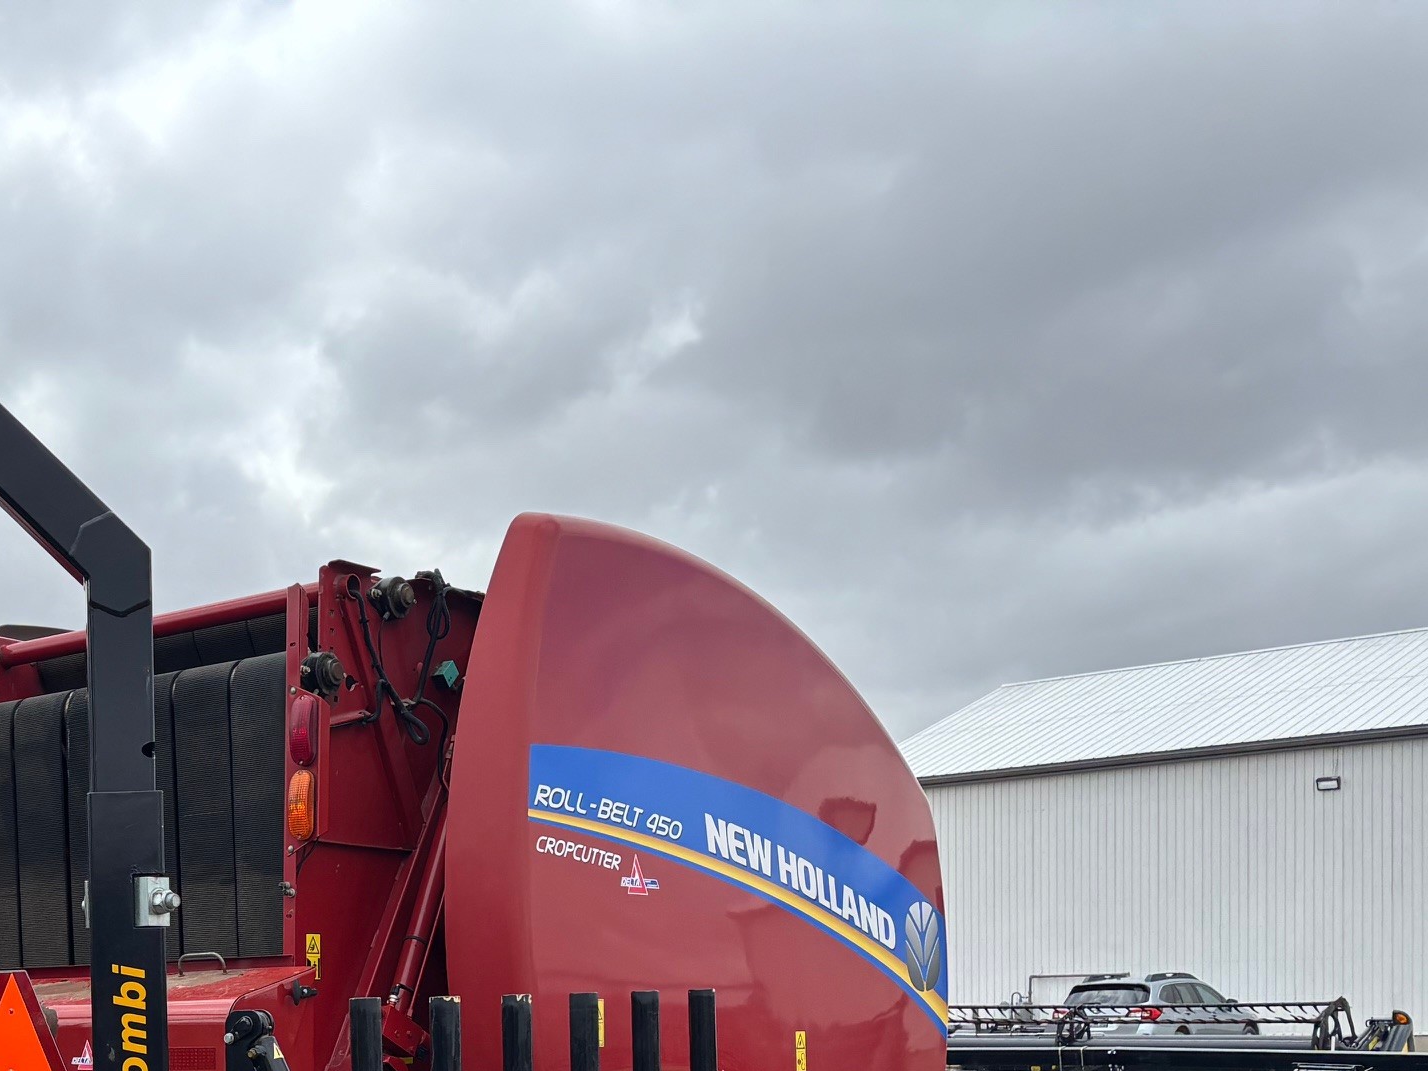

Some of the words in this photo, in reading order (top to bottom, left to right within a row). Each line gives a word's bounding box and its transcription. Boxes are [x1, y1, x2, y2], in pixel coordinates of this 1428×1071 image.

[534, 784, 643, 829] ROLL-BELT
[646, 813, 683, 840] 450
[536, 835, 622, 871] CROPCUTTER
[704, 812, 771, 877] NEW
[777, 844, 896, 950] HOLLAND
